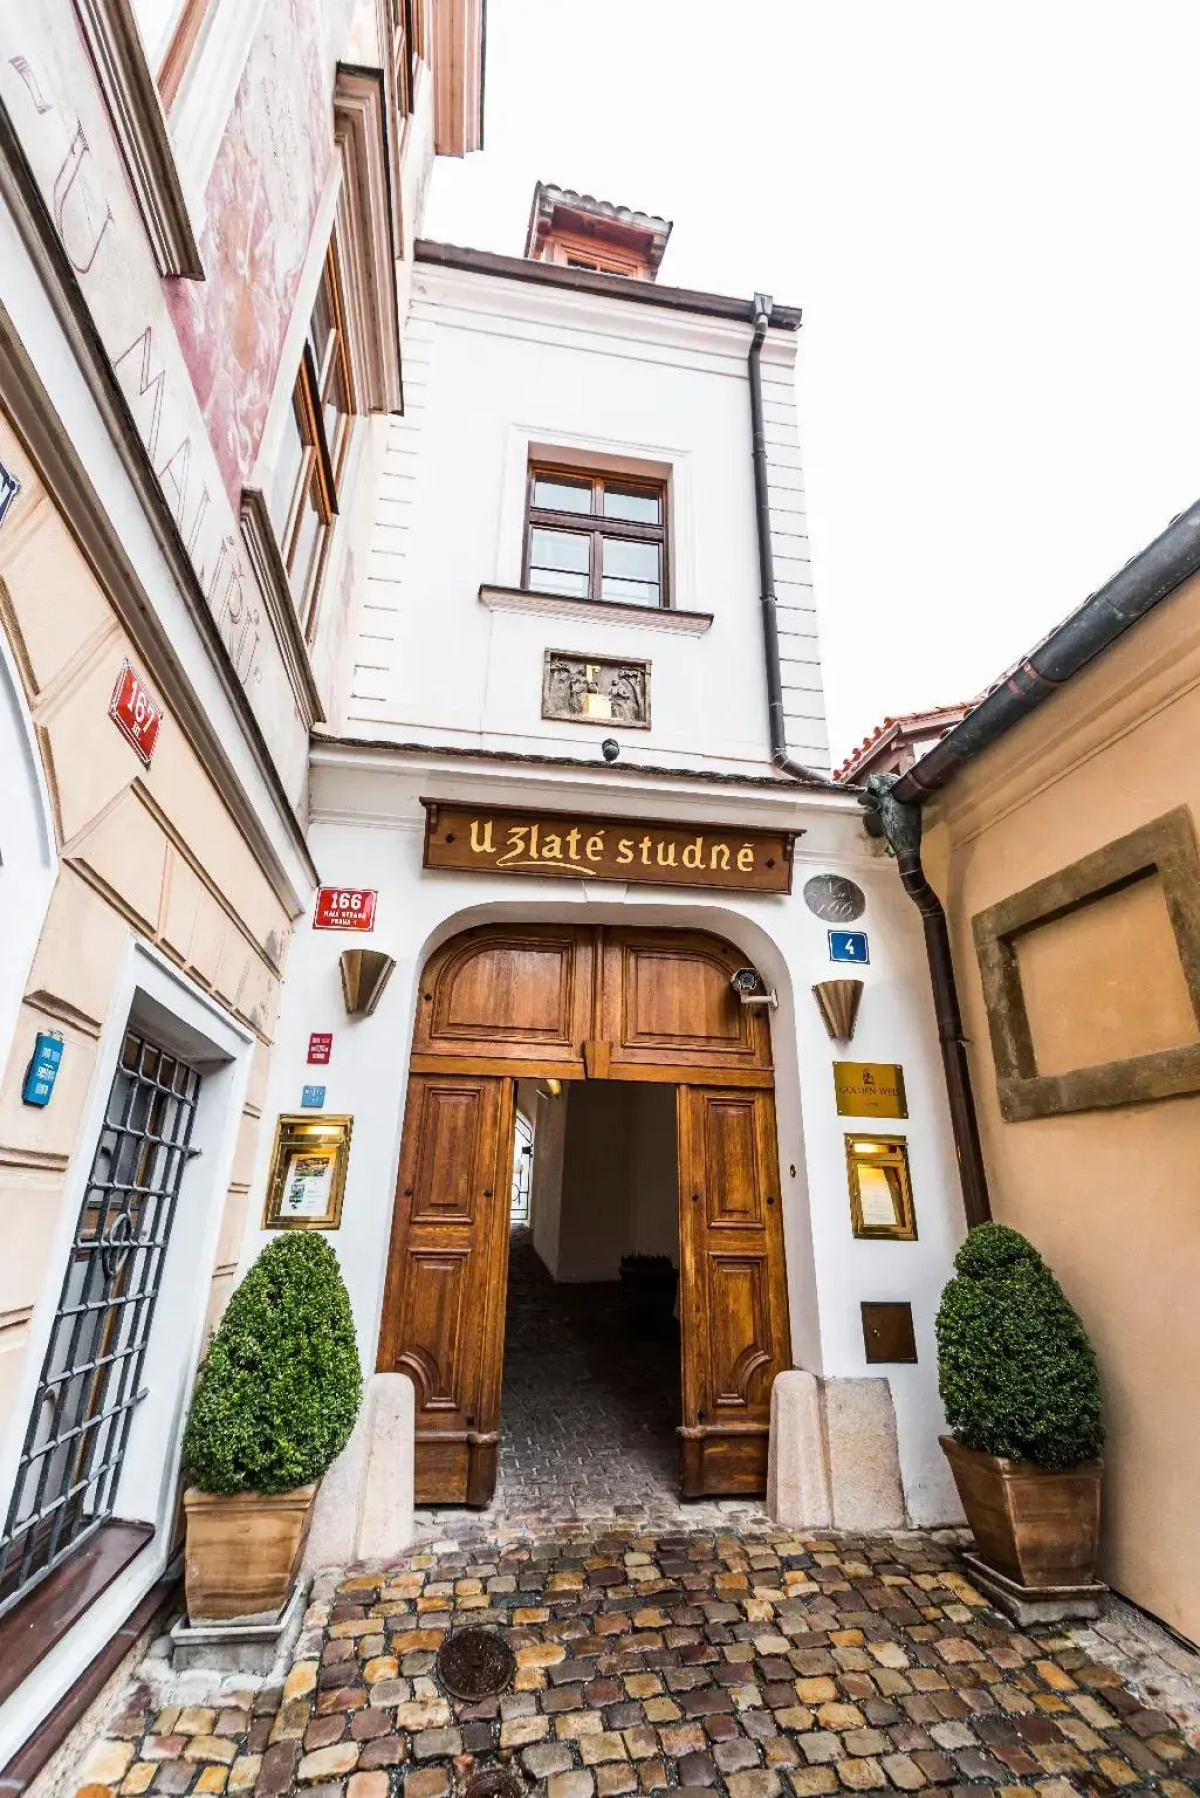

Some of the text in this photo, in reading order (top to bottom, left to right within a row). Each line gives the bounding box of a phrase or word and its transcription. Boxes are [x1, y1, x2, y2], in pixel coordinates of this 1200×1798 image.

[127, 680, 156, 734] 167
[470, 820, 497, 853] U
[330, 891, 363, 910] 166
[844, 938, 855, 955] 4
